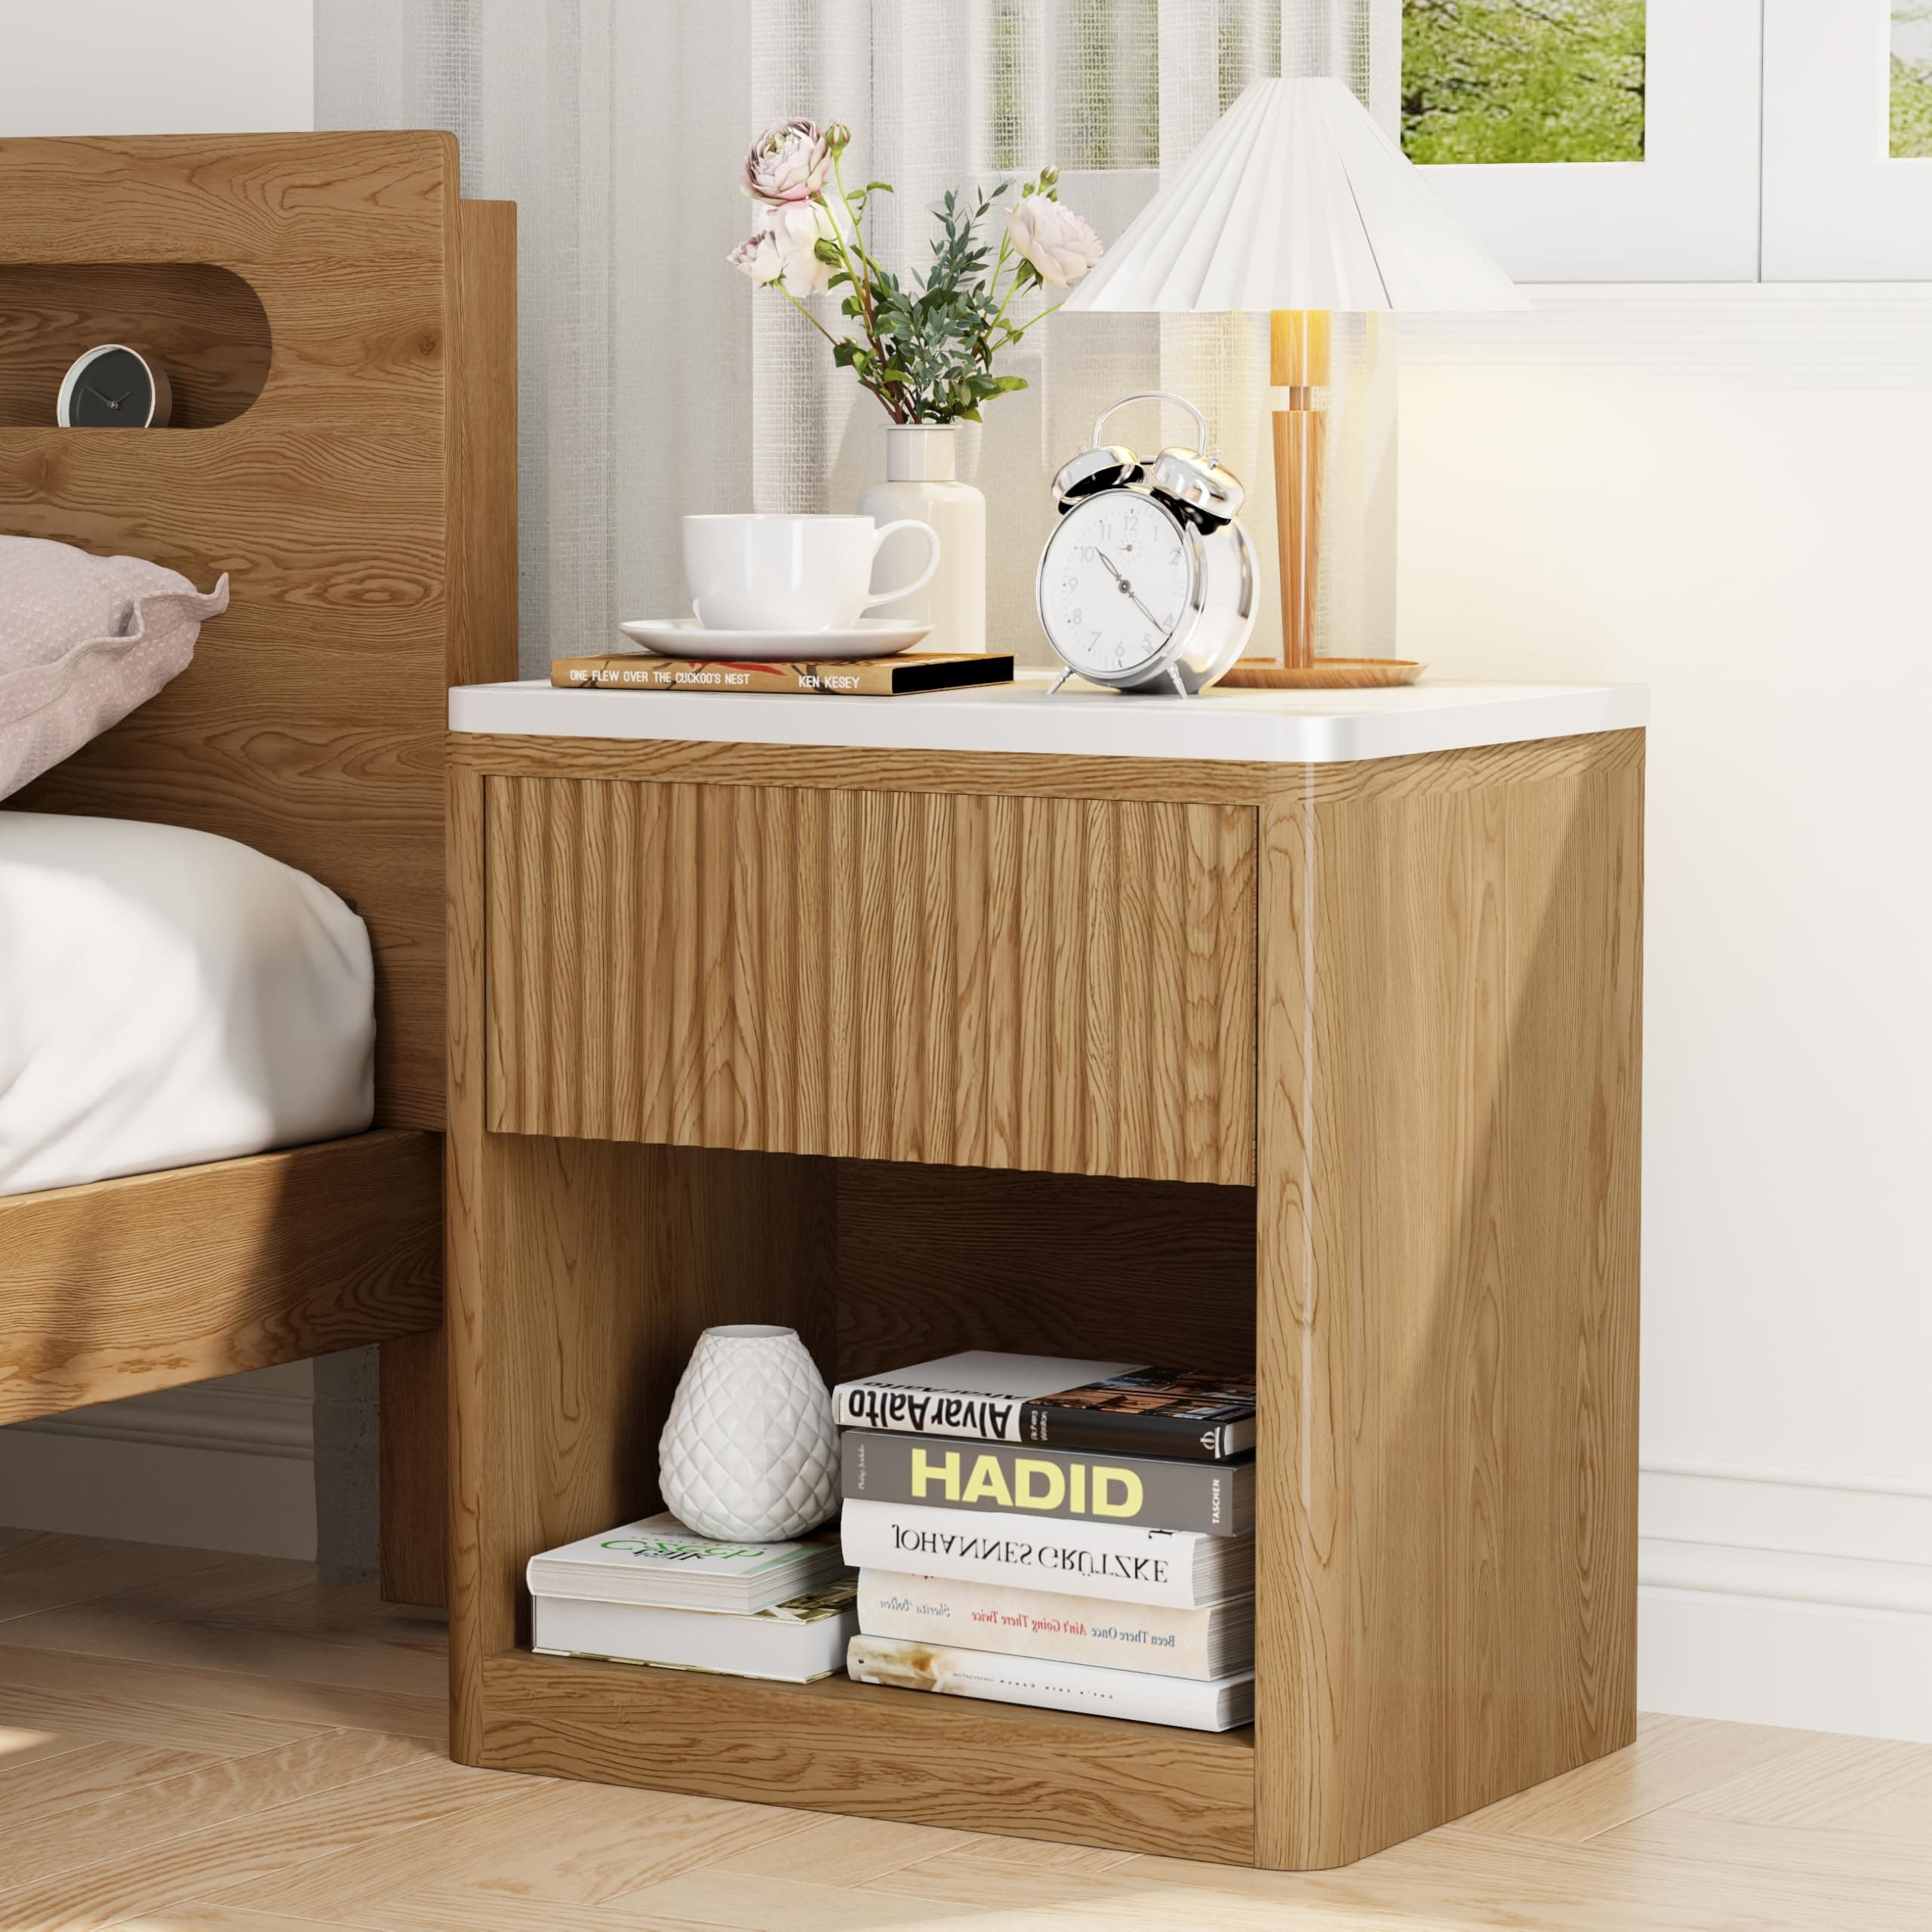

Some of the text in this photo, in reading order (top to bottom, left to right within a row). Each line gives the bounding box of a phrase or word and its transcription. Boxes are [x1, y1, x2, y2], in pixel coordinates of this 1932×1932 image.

[1123, 516, 1139, 531] 12
[1080, 546, 1094, 563] 10
[570, 670, 750, 685] ONE FLEW OVER THE CUCKOO'S NEST
[798, 675, 860, 689] KEN KESEY
[911, 1447, 1143, 1518] HADID
